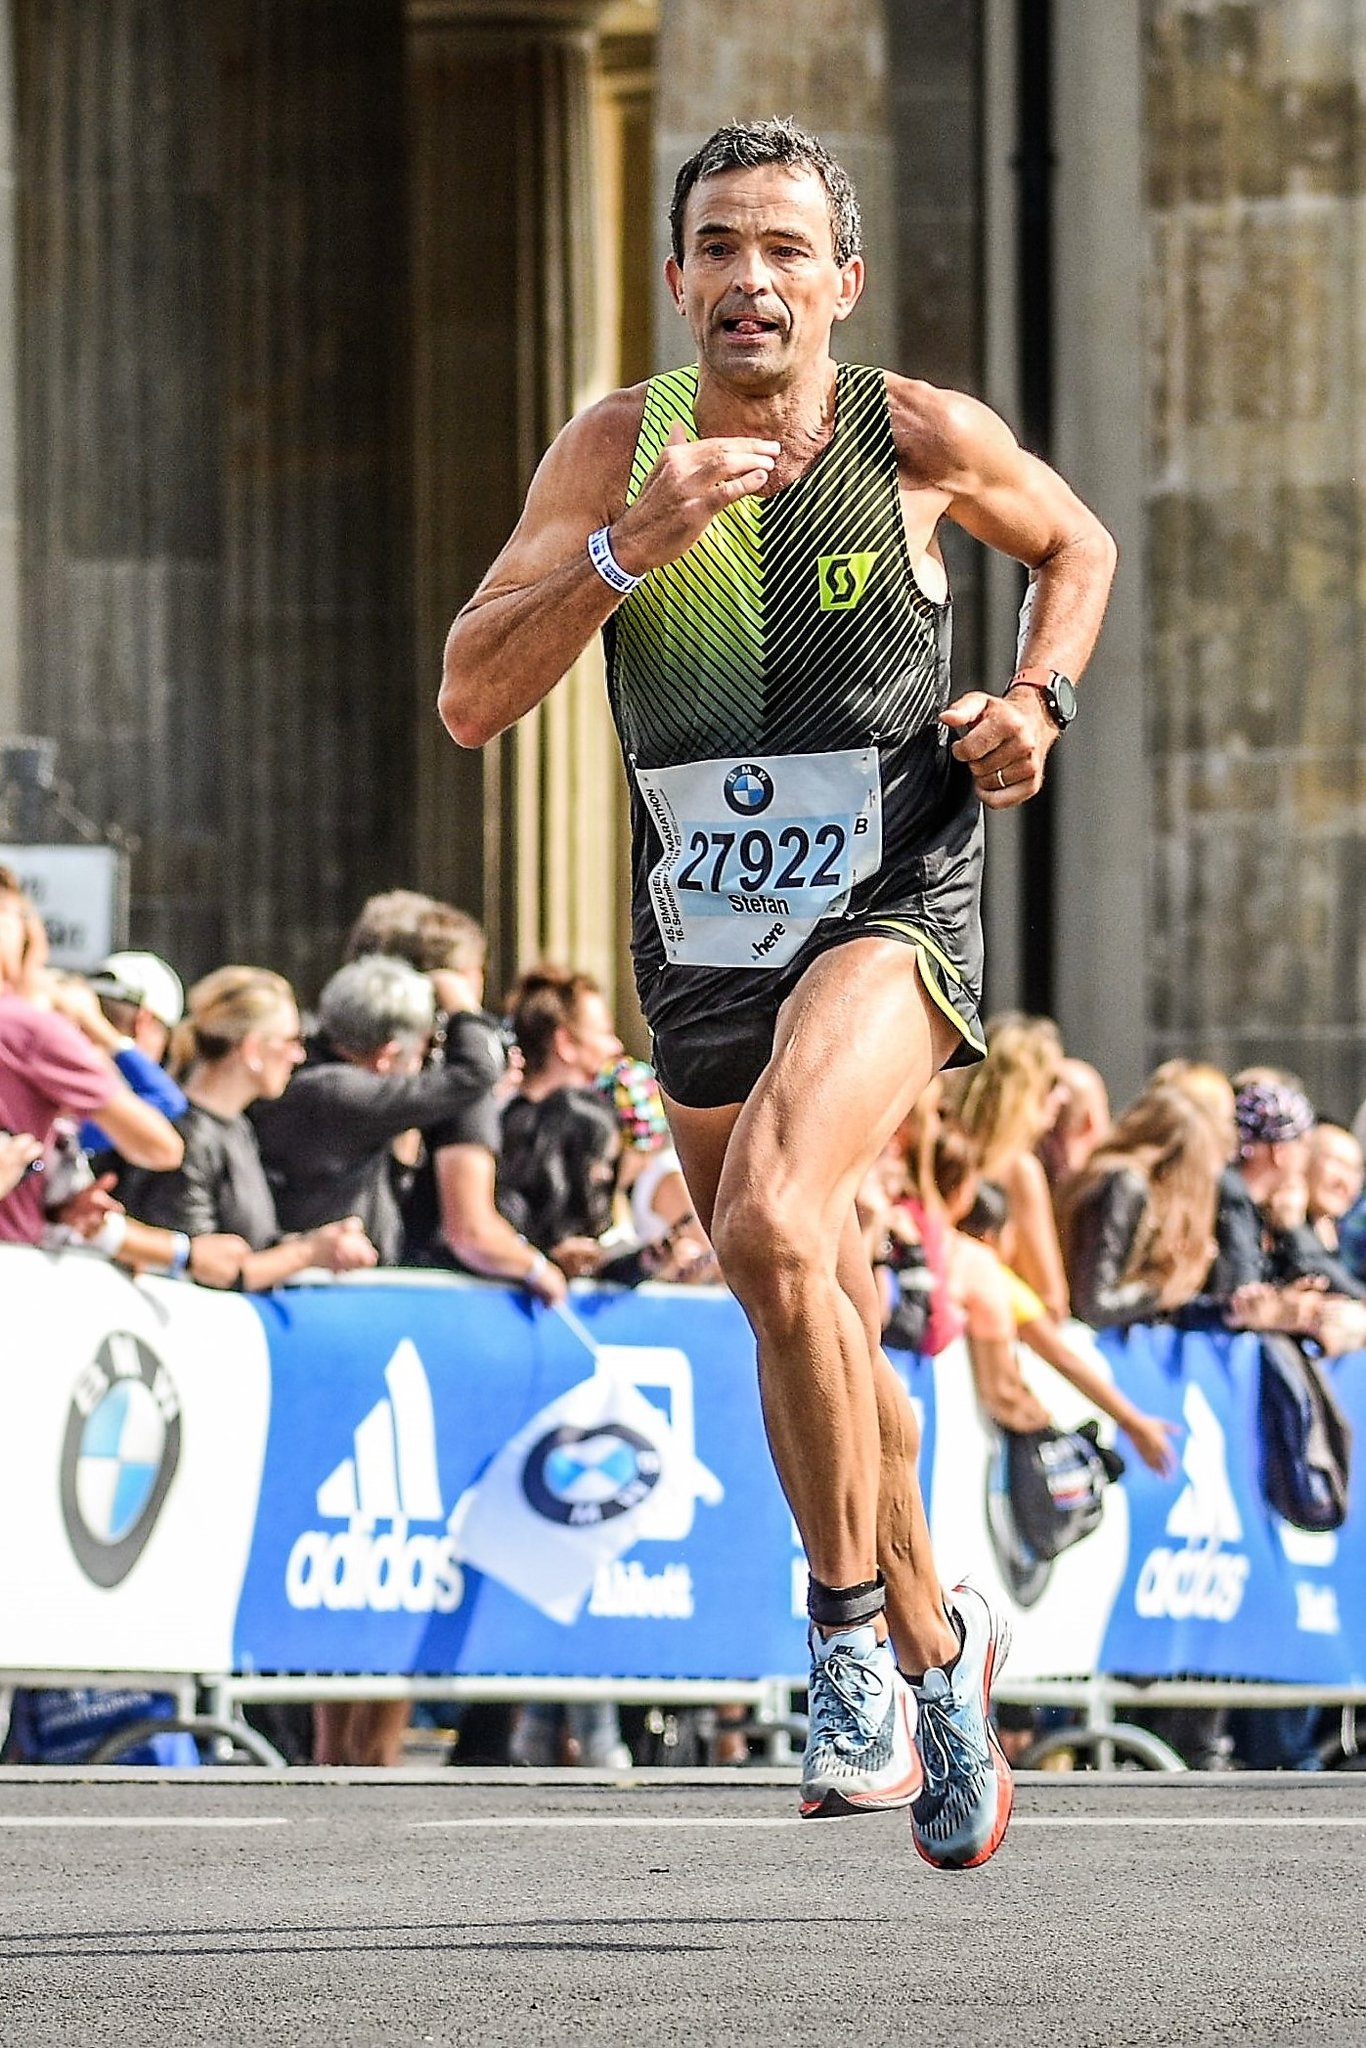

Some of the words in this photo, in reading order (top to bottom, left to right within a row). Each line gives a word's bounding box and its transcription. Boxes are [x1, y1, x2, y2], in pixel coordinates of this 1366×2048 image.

[727, 765, 768, 783] BMW
[854, 818, 869, 835] B
[677, 824, 846, 893] 27922
[656, 895, 671, 924] BMW
[663, 873, 682, 926] September
[727, 894, 790, 915] Stefan
[665, 926, 676, 942] 45.
[752, 921, 786, 957] here
[286, 1518, 464, 1614] adidas
